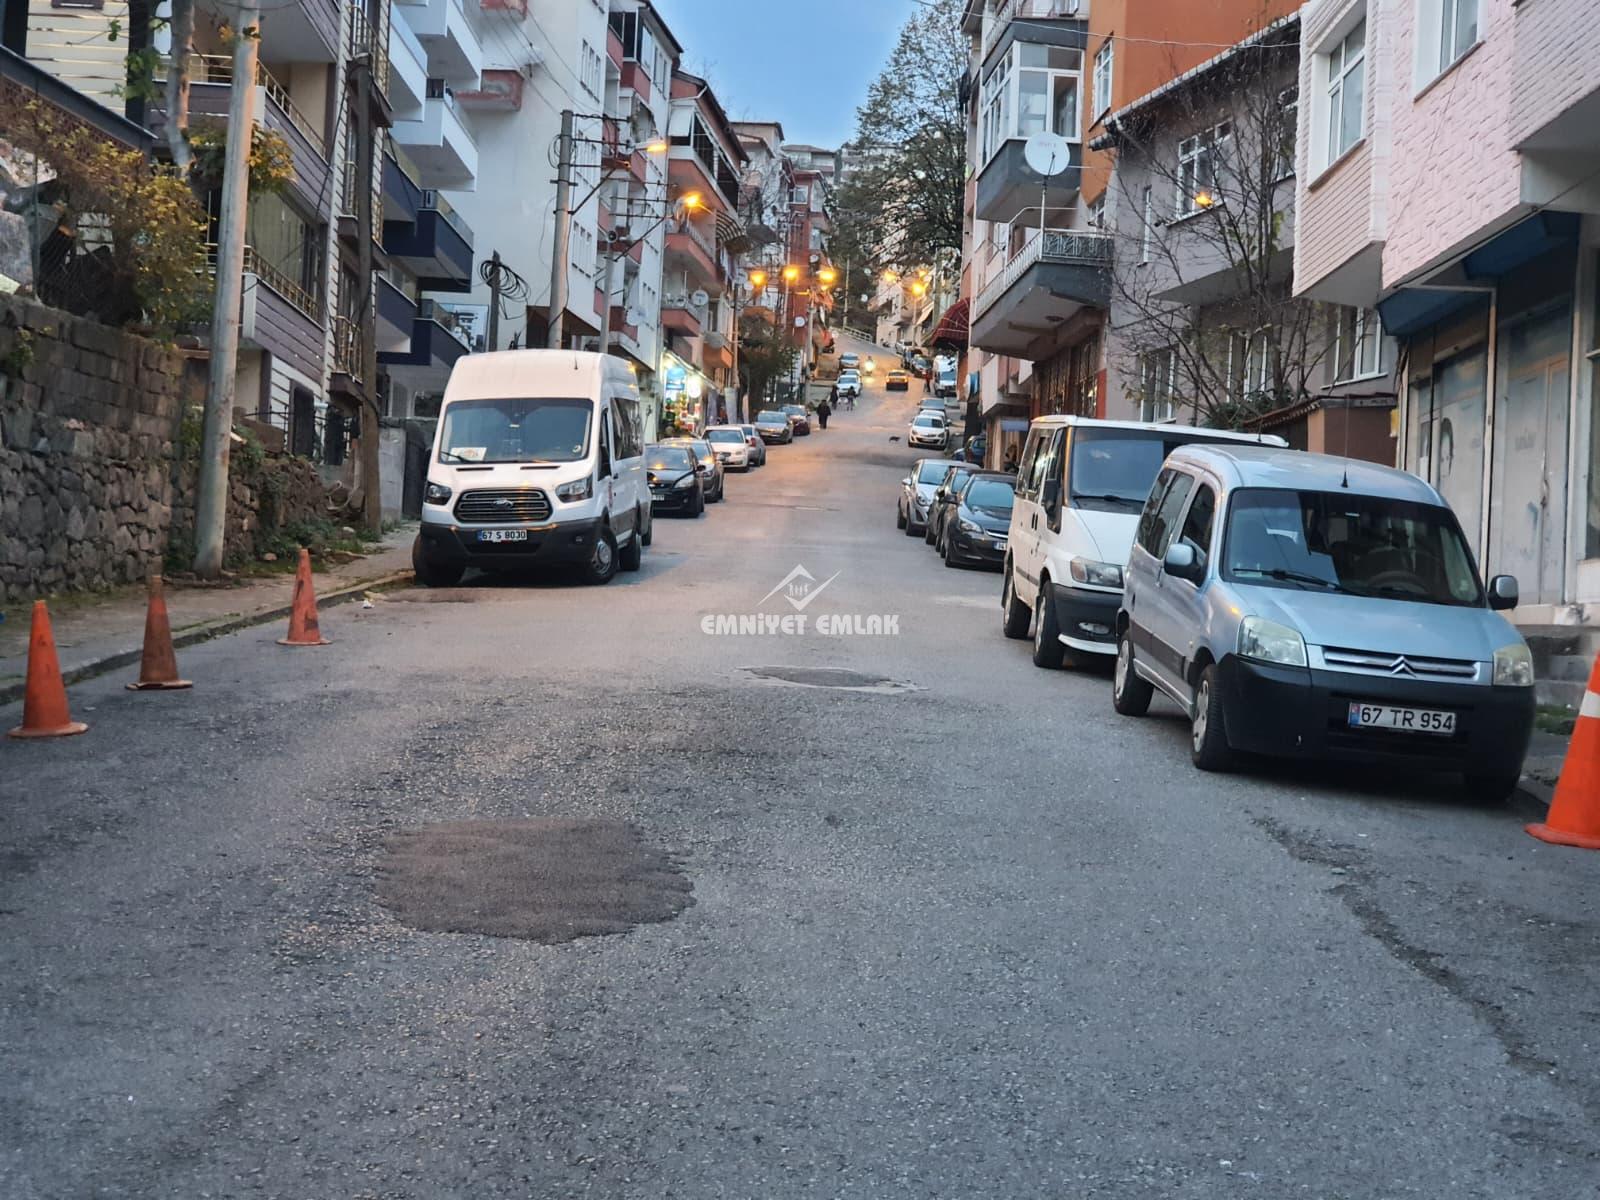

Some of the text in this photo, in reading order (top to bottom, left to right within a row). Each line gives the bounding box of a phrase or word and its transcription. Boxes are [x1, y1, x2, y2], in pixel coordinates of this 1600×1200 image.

[482, 532, 493, 540] 67
[505, 531, 526, 539] 8030
[1361, 706, 1453, 731] 67 TR 954
